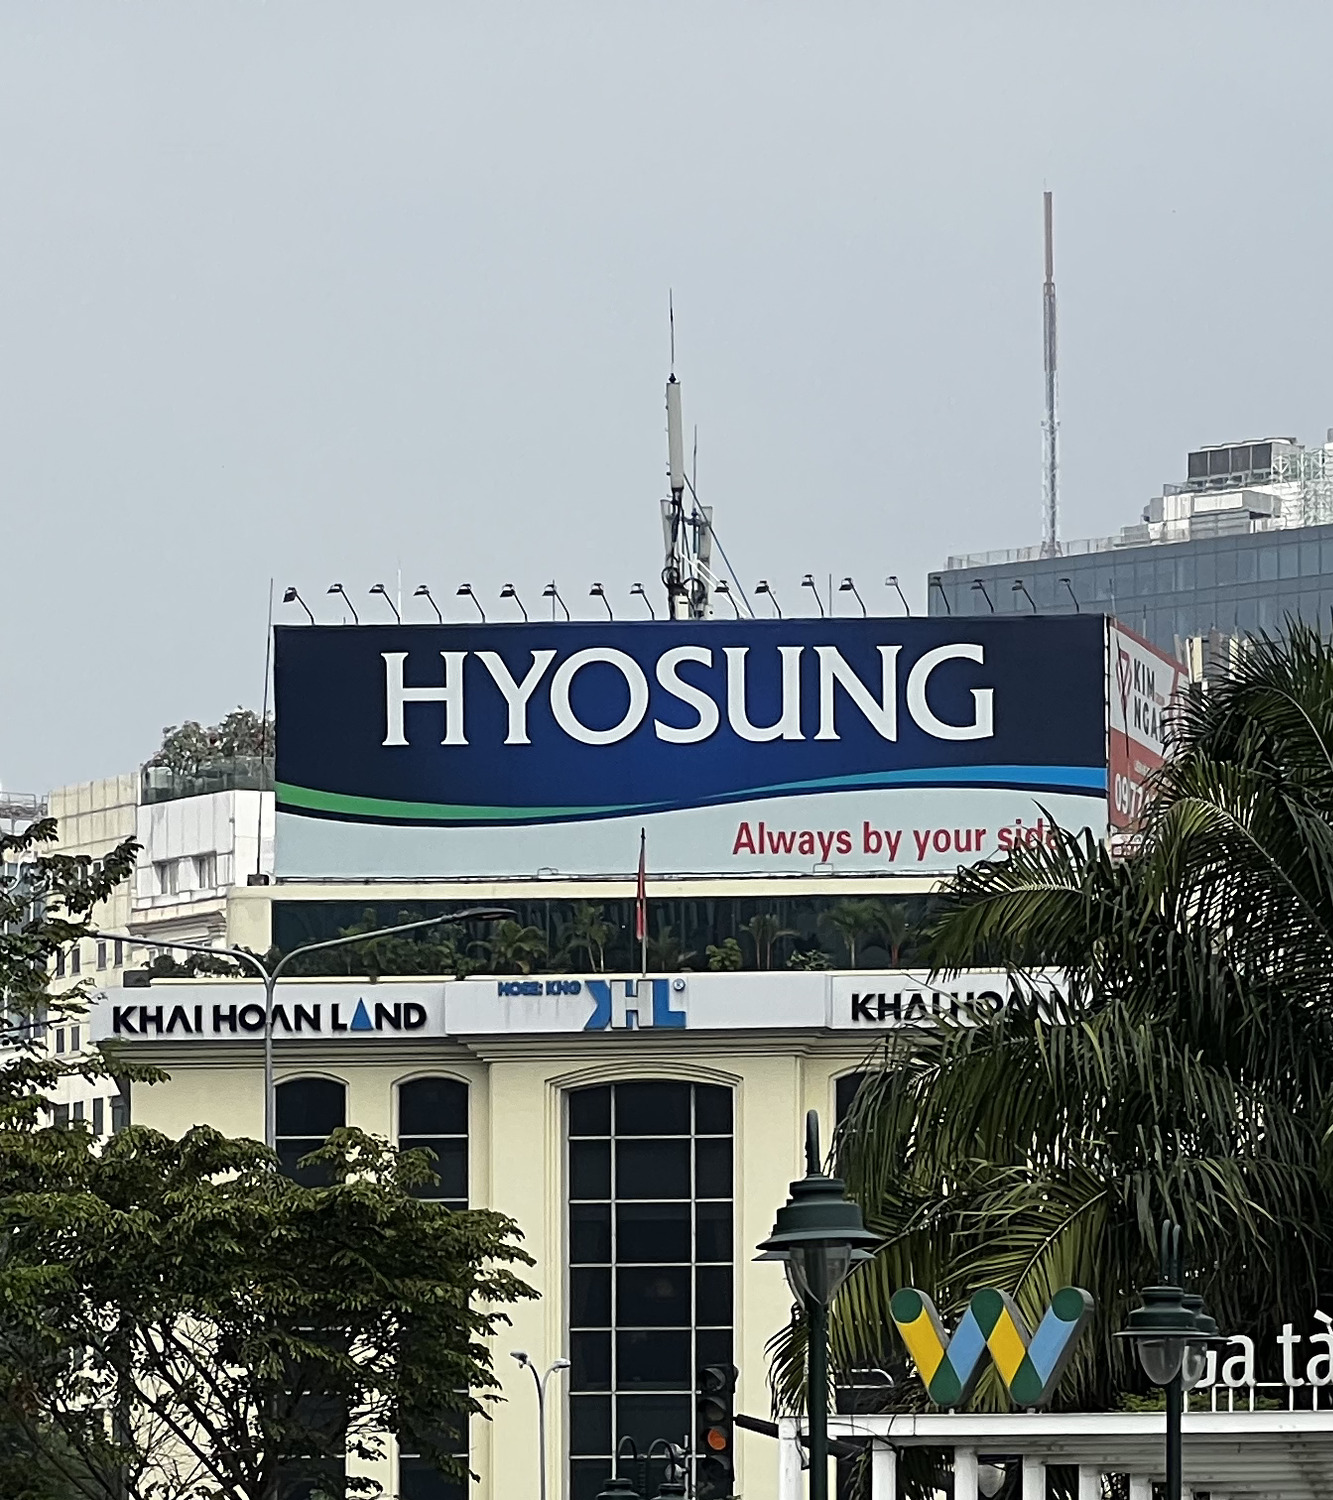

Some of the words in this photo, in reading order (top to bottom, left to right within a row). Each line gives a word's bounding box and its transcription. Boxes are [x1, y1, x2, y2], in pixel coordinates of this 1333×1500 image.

[380, 643, 995, 747] HYOSUNG
[1133, 657, 1155, 702] KIM
[732, 820, 852, 863] Always
[862, 820, 902, 863] by
[912, 828, 987, 862] your
[112, 1004, 202, 1034] KHAI
[213, 1003, 321, 1033] HOAN
[331, 997, 427, 1031] LAND
